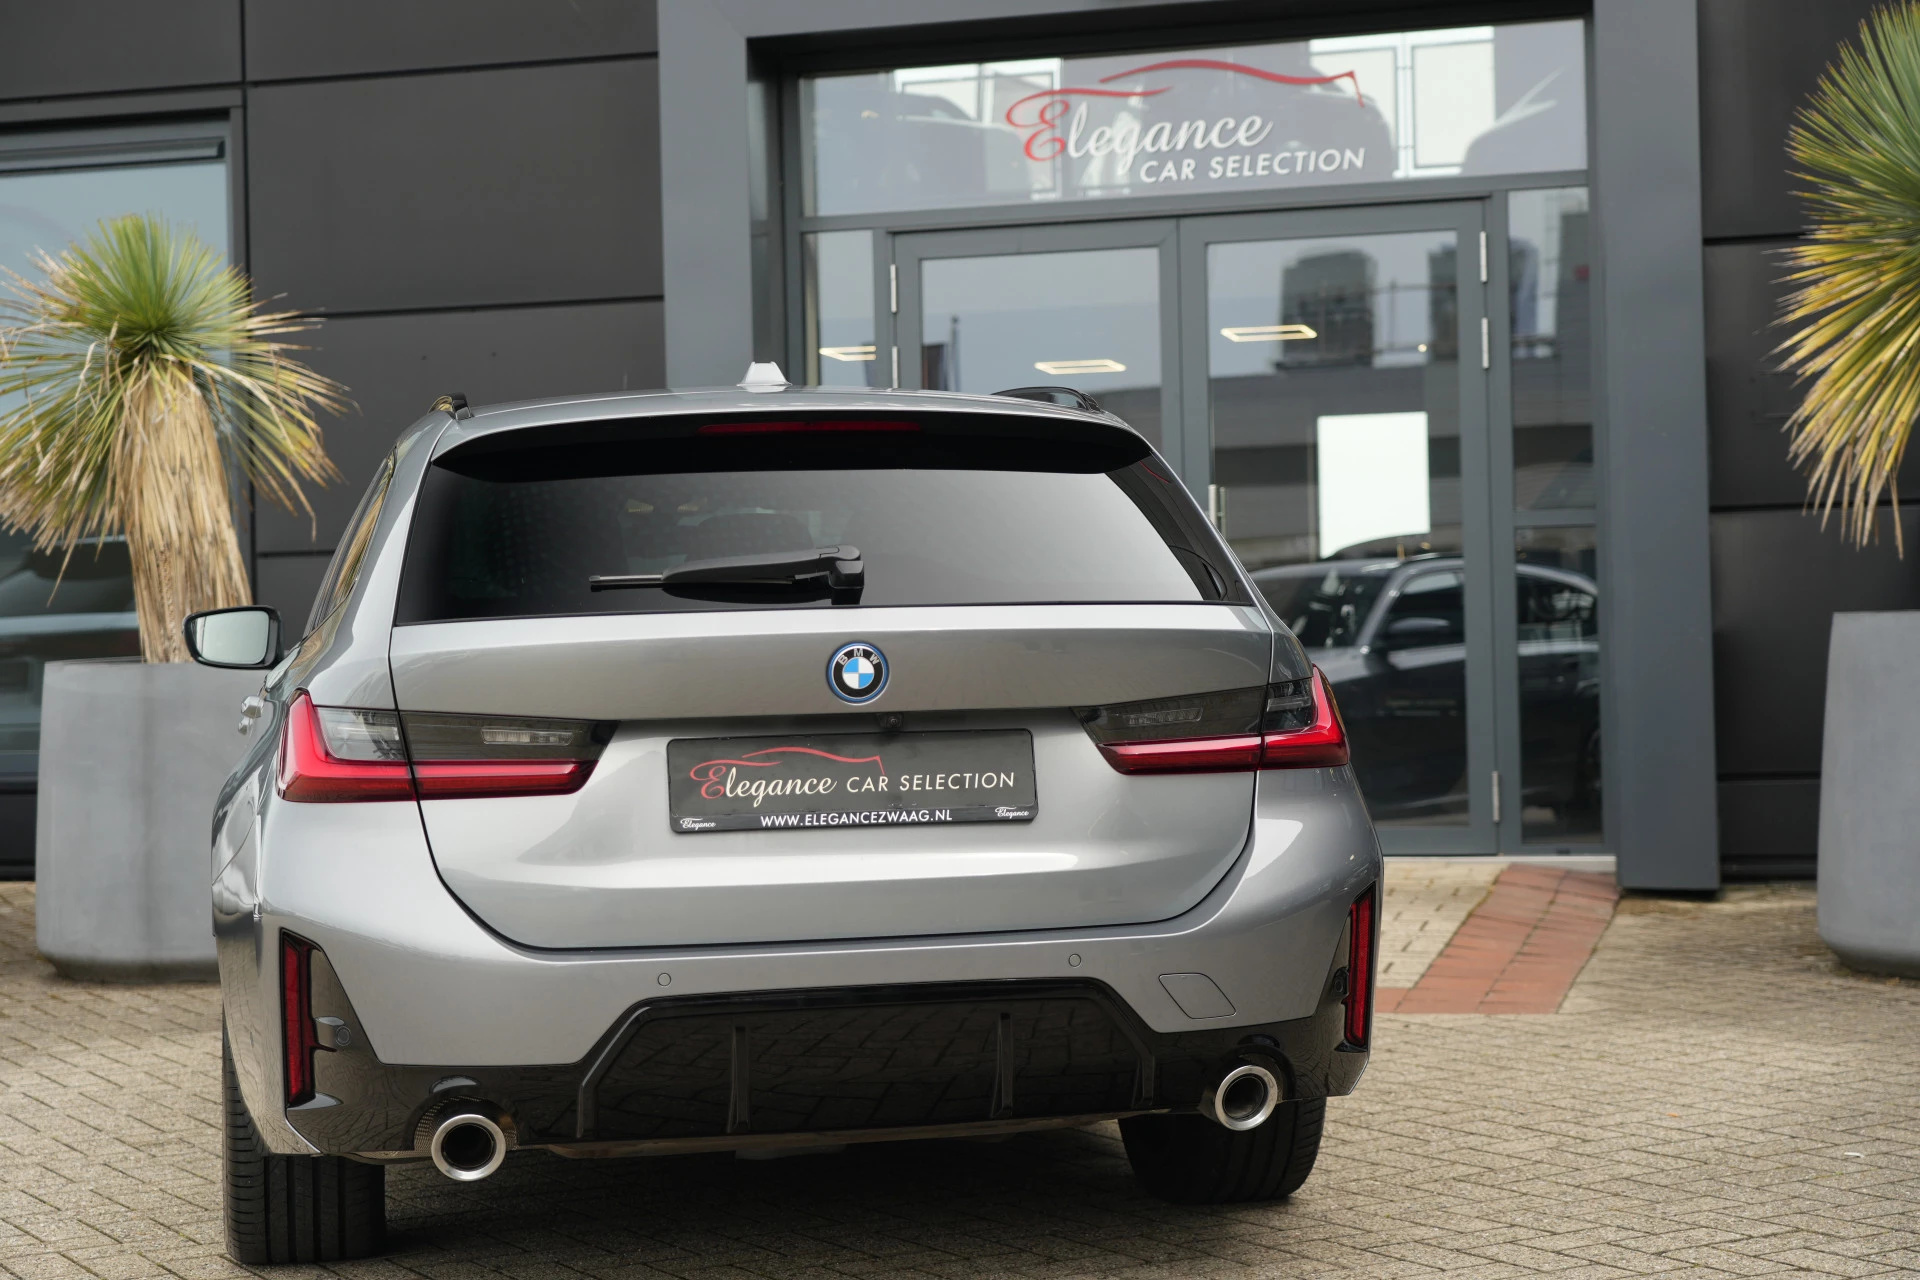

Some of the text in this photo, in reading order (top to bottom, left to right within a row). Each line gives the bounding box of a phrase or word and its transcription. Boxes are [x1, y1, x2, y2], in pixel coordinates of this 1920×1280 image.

[1006, 96, 1274, 176] Elegance
[1140, 147, 1366, 184] CAR SELECTION
[837, 647, 880, 666] BMW
[690, 764, 1016, 808] Elegance CAR SELECTION
[760, 808, 953, 828] WWW.ELEGANCEZWAAG.NL
